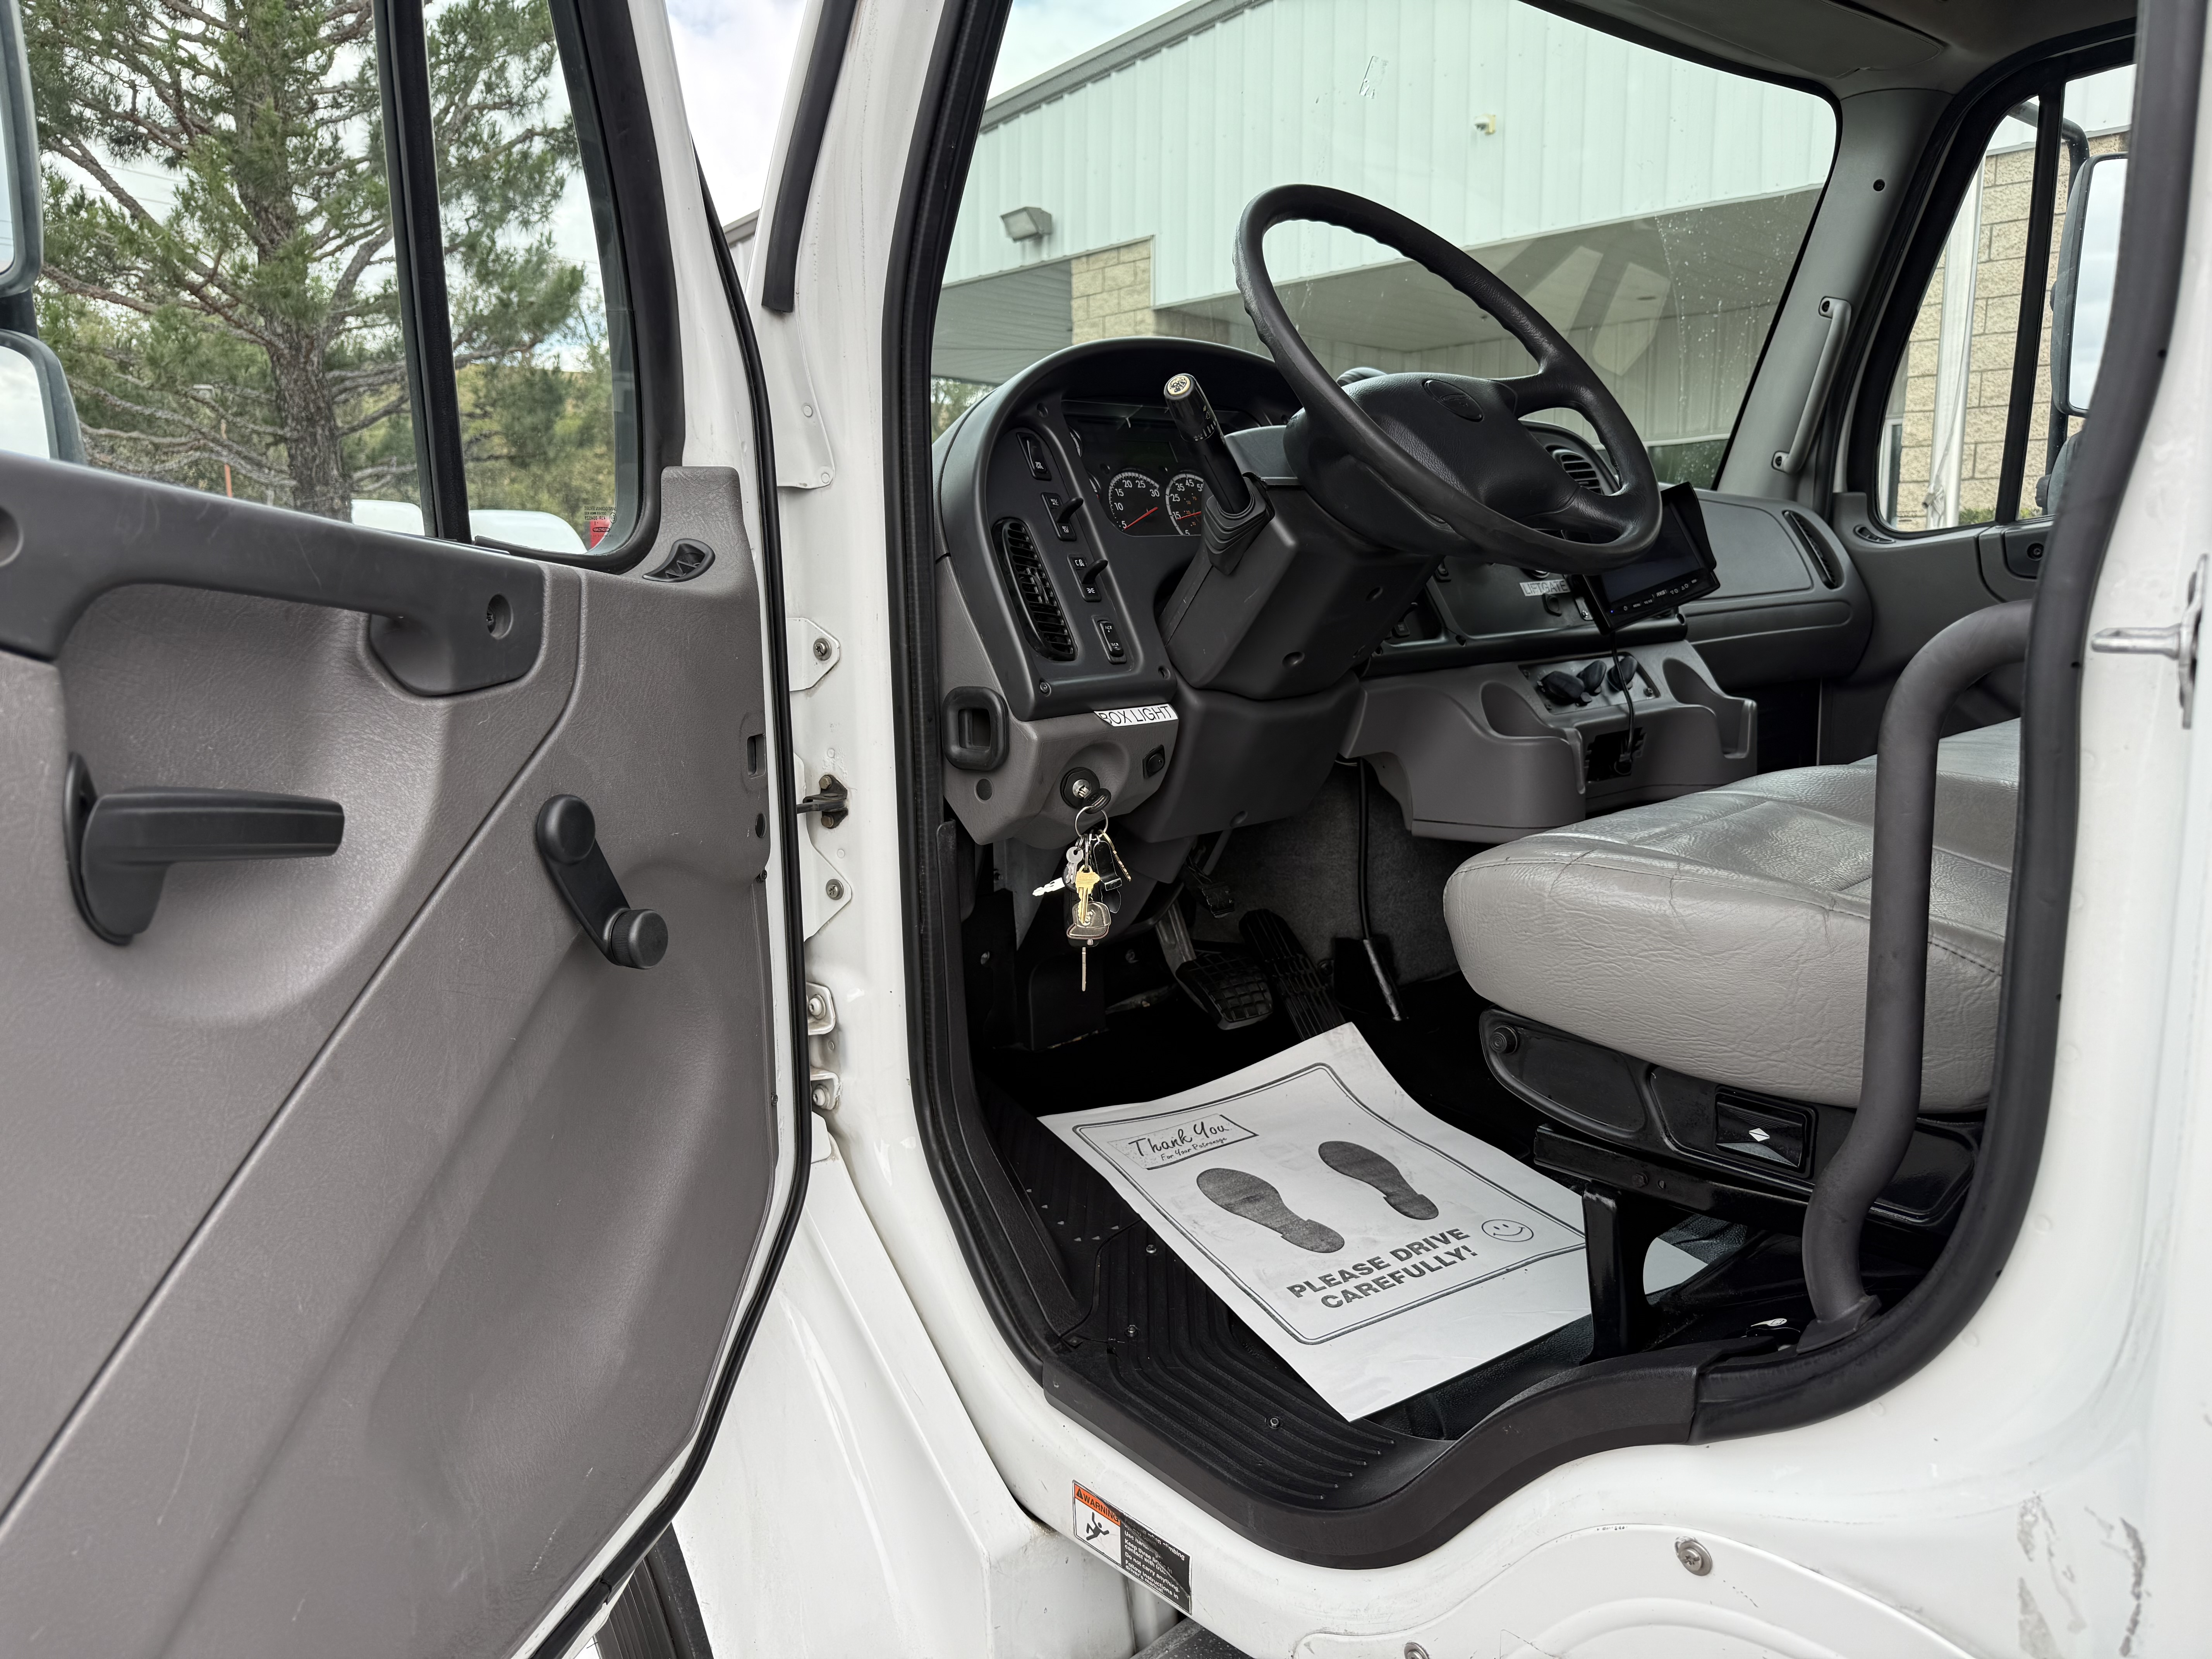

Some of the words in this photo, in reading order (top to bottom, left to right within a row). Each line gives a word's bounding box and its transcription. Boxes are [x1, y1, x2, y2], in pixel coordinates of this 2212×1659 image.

[1173, 512, 1181, 520] 15
[1522, 580, 1568, 594] LIFTGATE
[1098, 711, 1132, 724] BOX
[1130, 706, 1171, 722] LIGHT
[1128, 1128, 1193, 1157] Thank
[1194, 1121, 1230, 1139] You
[1192, 1137, 1227, 1150] Patronage
[1286, 1256, 1391, 1298] PLEASE
[1389, 1228, 1471, 1262] DRIVE
[1321, 1245, 1478, 1308] CAREFULLY!
[1083, 1493, 1119, 1523] WARNING
[1125, 1530, 1134, 1540] Use
[1125, 1538, 1137, 1551] Keep
[1138, 1547, 1151, 1559] three
[1125, 1544, 1143, 1559] contact
[1144, 1557, 1155, 1567] with
[1125, 1551, 1132, 1560] Do
[1133, 1558, 1141, 1566] not
[1142, 1564, 1155, 1576] carry
[1156, 1573, 1180, 1592] anything.
[1125, 1559, 1142, 1574] Follow
[1142, 1571, 1173, 1595] instructions
[1144, 1578, 1165, 1594] manual.
